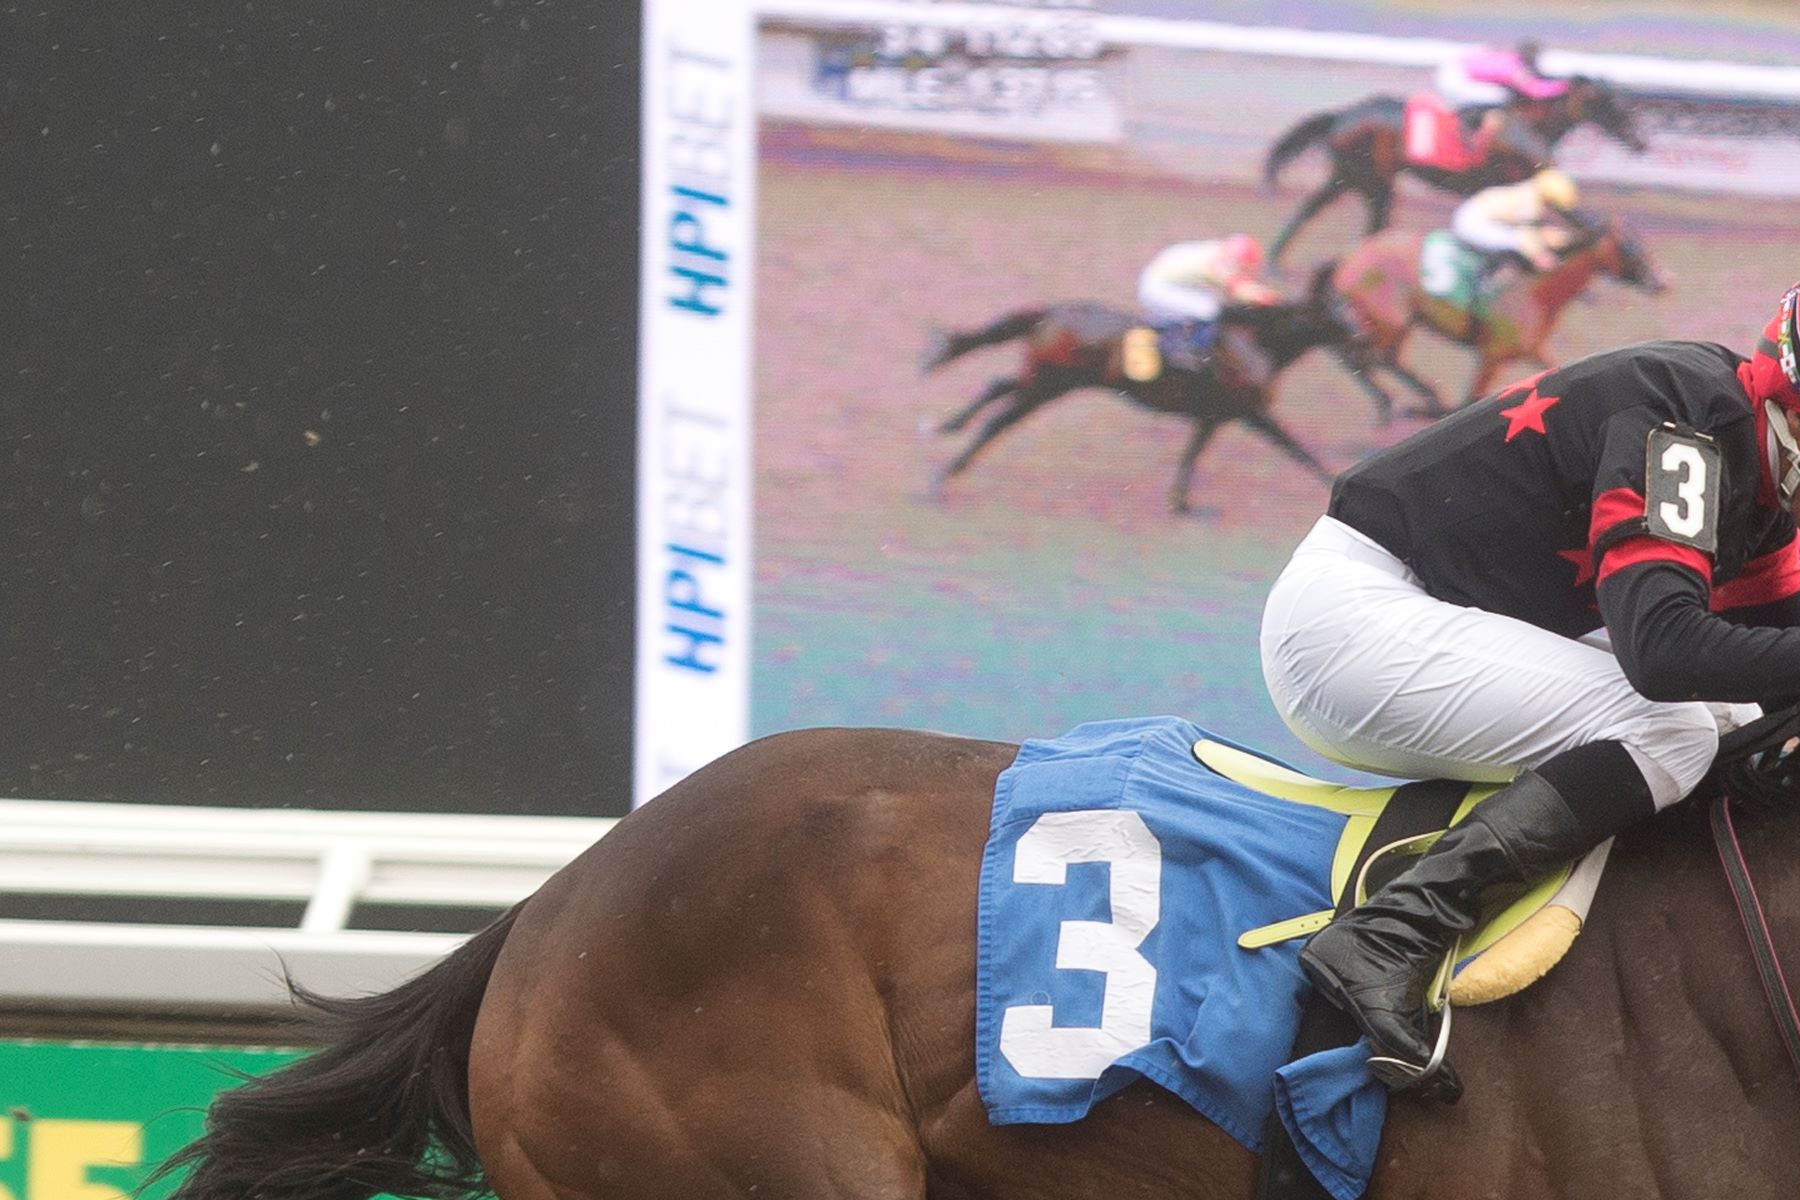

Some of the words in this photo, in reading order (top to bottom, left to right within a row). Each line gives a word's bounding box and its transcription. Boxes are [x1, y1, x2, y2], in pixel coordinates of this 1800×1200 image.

[665, 34, 731, 318] HPIBET
[662, 392, 729, 675] HPIBET
[1660, 443, 1706, 538] 3
[1000, 809, 1161, 1079] 3
